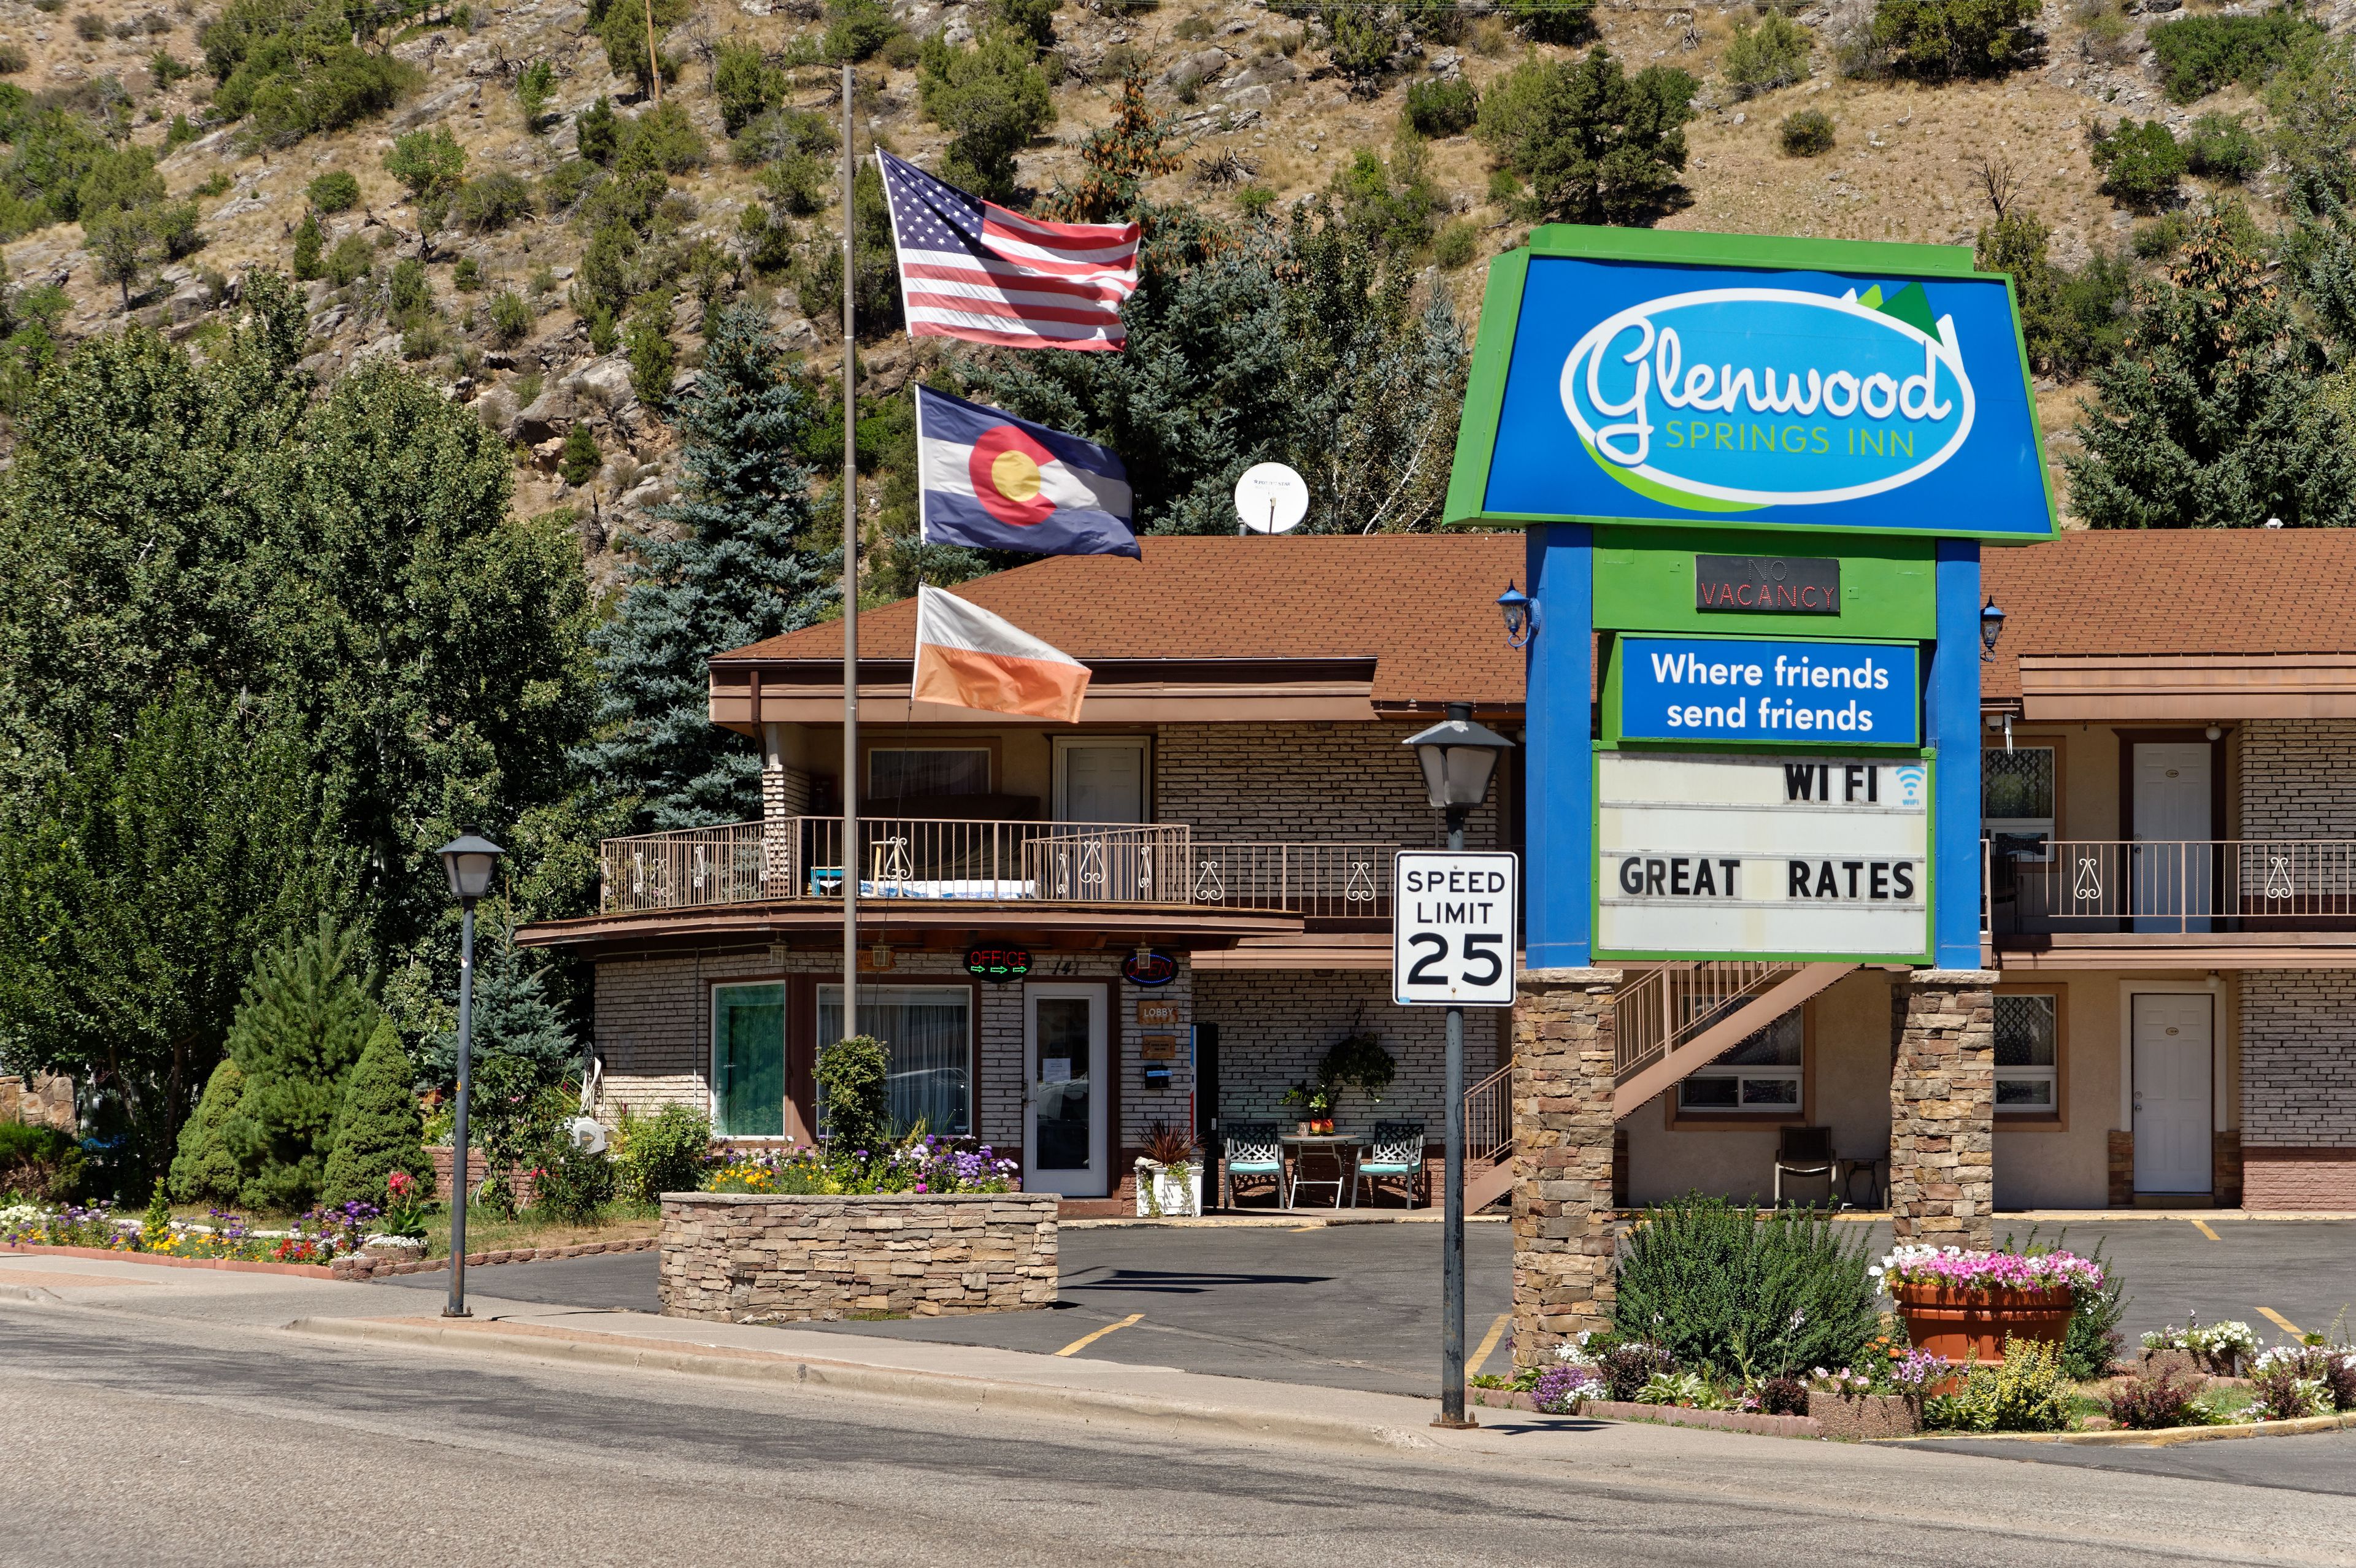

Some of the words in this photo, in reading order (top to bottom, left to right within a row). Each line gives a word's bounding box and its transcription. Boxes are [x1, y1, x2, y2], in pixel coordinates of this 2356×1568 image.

[1585, 315, 1954, 467] Glenwood
[1665, 420, 1830, 455] SPRINGS
[1849, 428, 1914, 458] INN
[1749, 559, 1787, 582] NO
[1701, 583, 1834, 608] VACANCY
[1651, 653, 1763, 686] Where
[1775, 656, 1889, 690] friends
[1666, 697, 1746, 728] send
[1758, 698, 1873, 731] friends
[1407, 870, 1505, 893] SPEED
[1620, 857, 1741, 896] GREAT
[1789, 860, 1914, 899] RATES
[1417, 902, 1493, 924] LIMIT
[971, 950, 1026, 966] OFFICE
[1052, 961, 1080, 975] 141
[1407, 932, 1503, 986] 25
[1144, 1007, 1173, 1017] LOBBY
